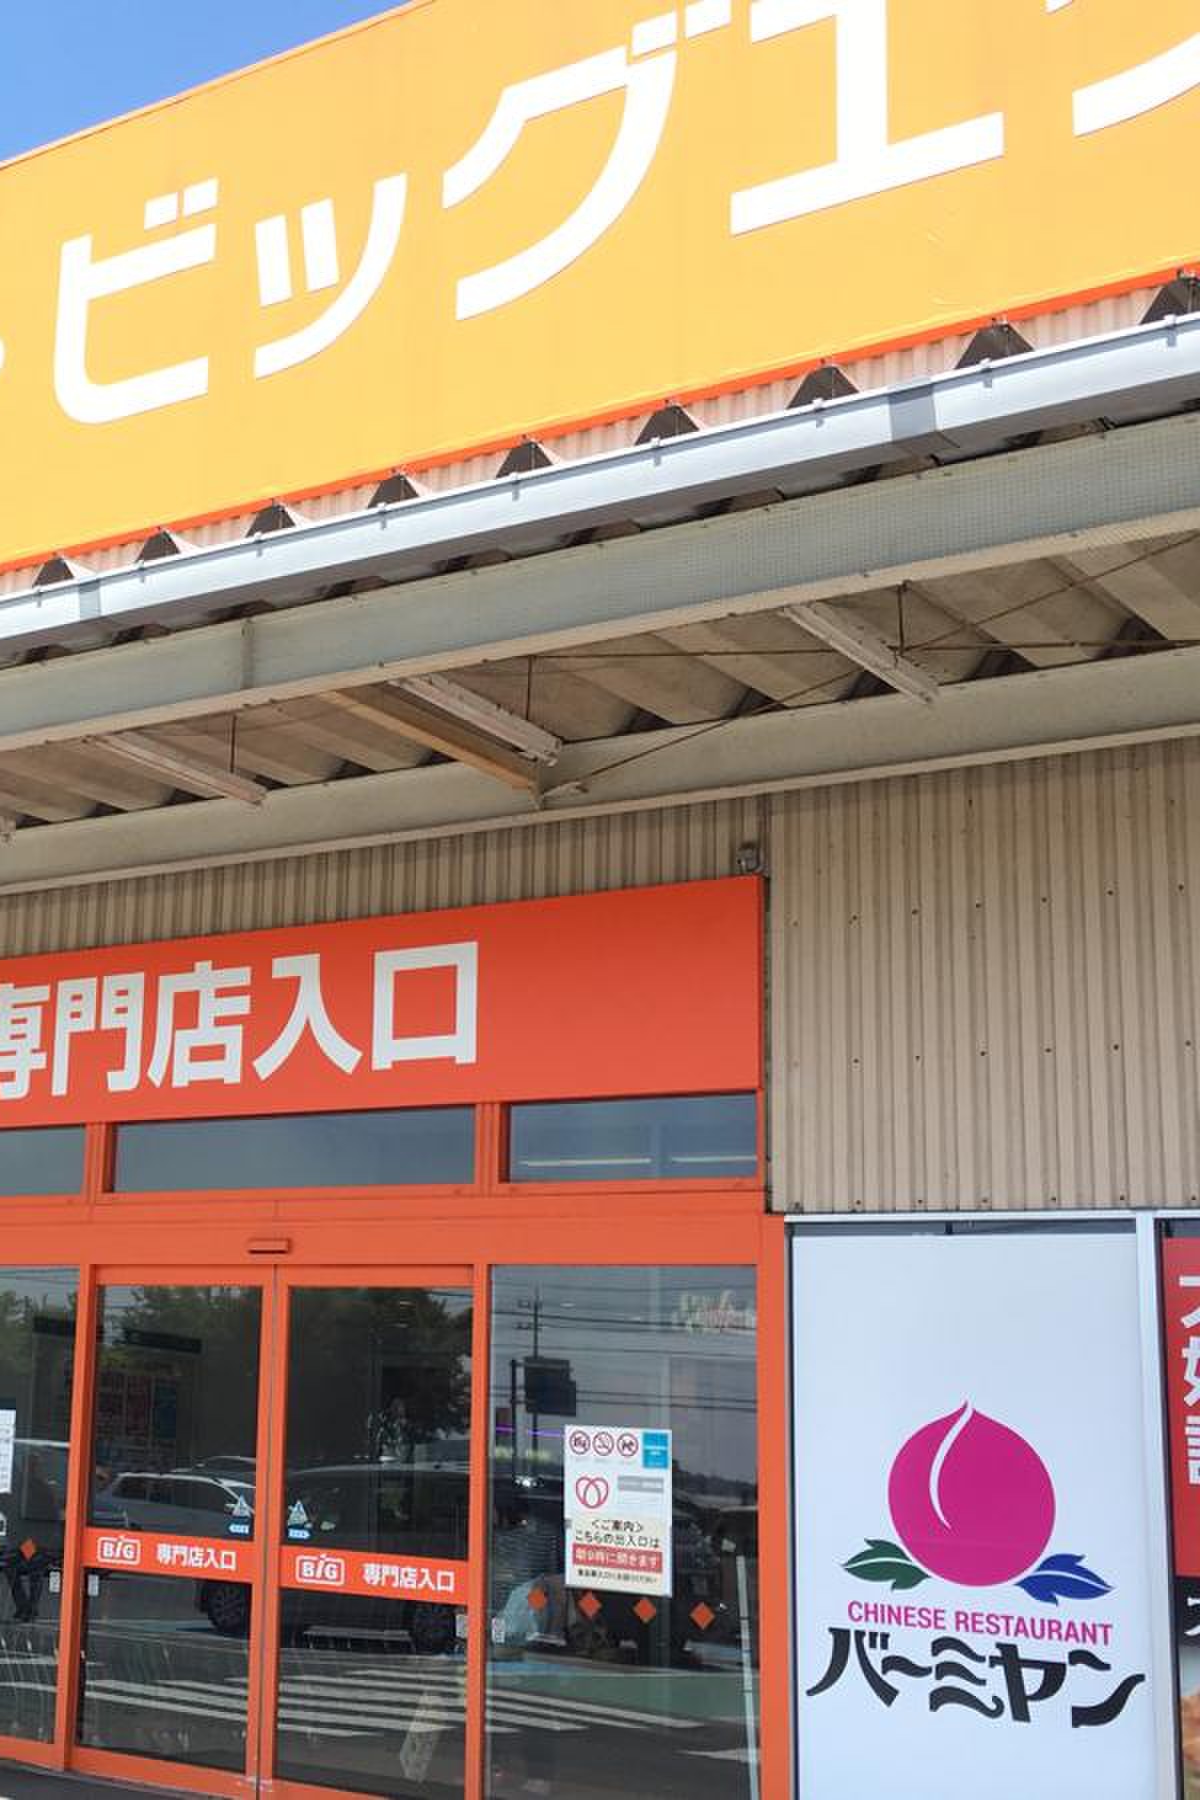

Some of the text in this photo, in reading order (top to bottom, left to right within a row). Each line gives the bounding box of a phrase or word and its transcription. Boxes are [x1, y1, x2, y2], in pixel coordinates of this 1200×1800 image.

[156, 1542, 237, 1570] 専門店入口
[362, 1562, 455, 1592] 専門店入口
[847, 1600, 1113, 1647] CHINESE RESTAURANT
[805, 1626, 1146, 1729] バーミヤン
